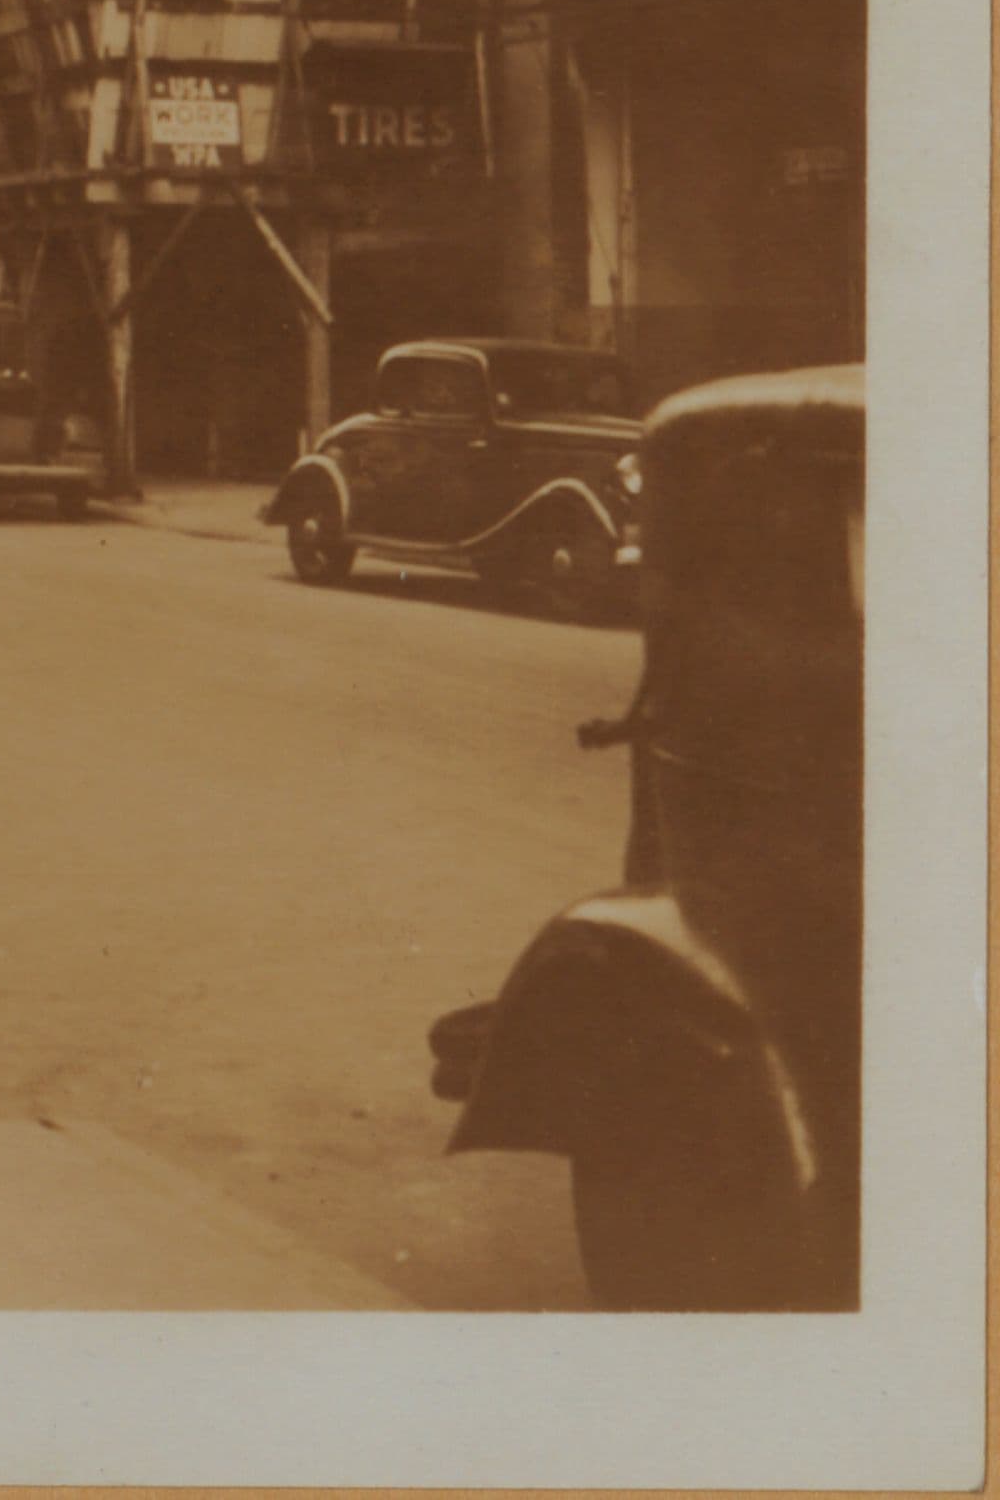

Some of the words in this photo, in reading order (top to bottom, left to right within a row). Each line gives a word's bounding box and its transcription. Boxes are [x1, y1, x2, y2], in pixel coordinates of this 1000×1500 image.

[168, 76, 215, 101] USA
[154, 104, 231, 125] WORK
[328, 103, 454, 148] TIRES
[170, 144, 221, 167] WPA
